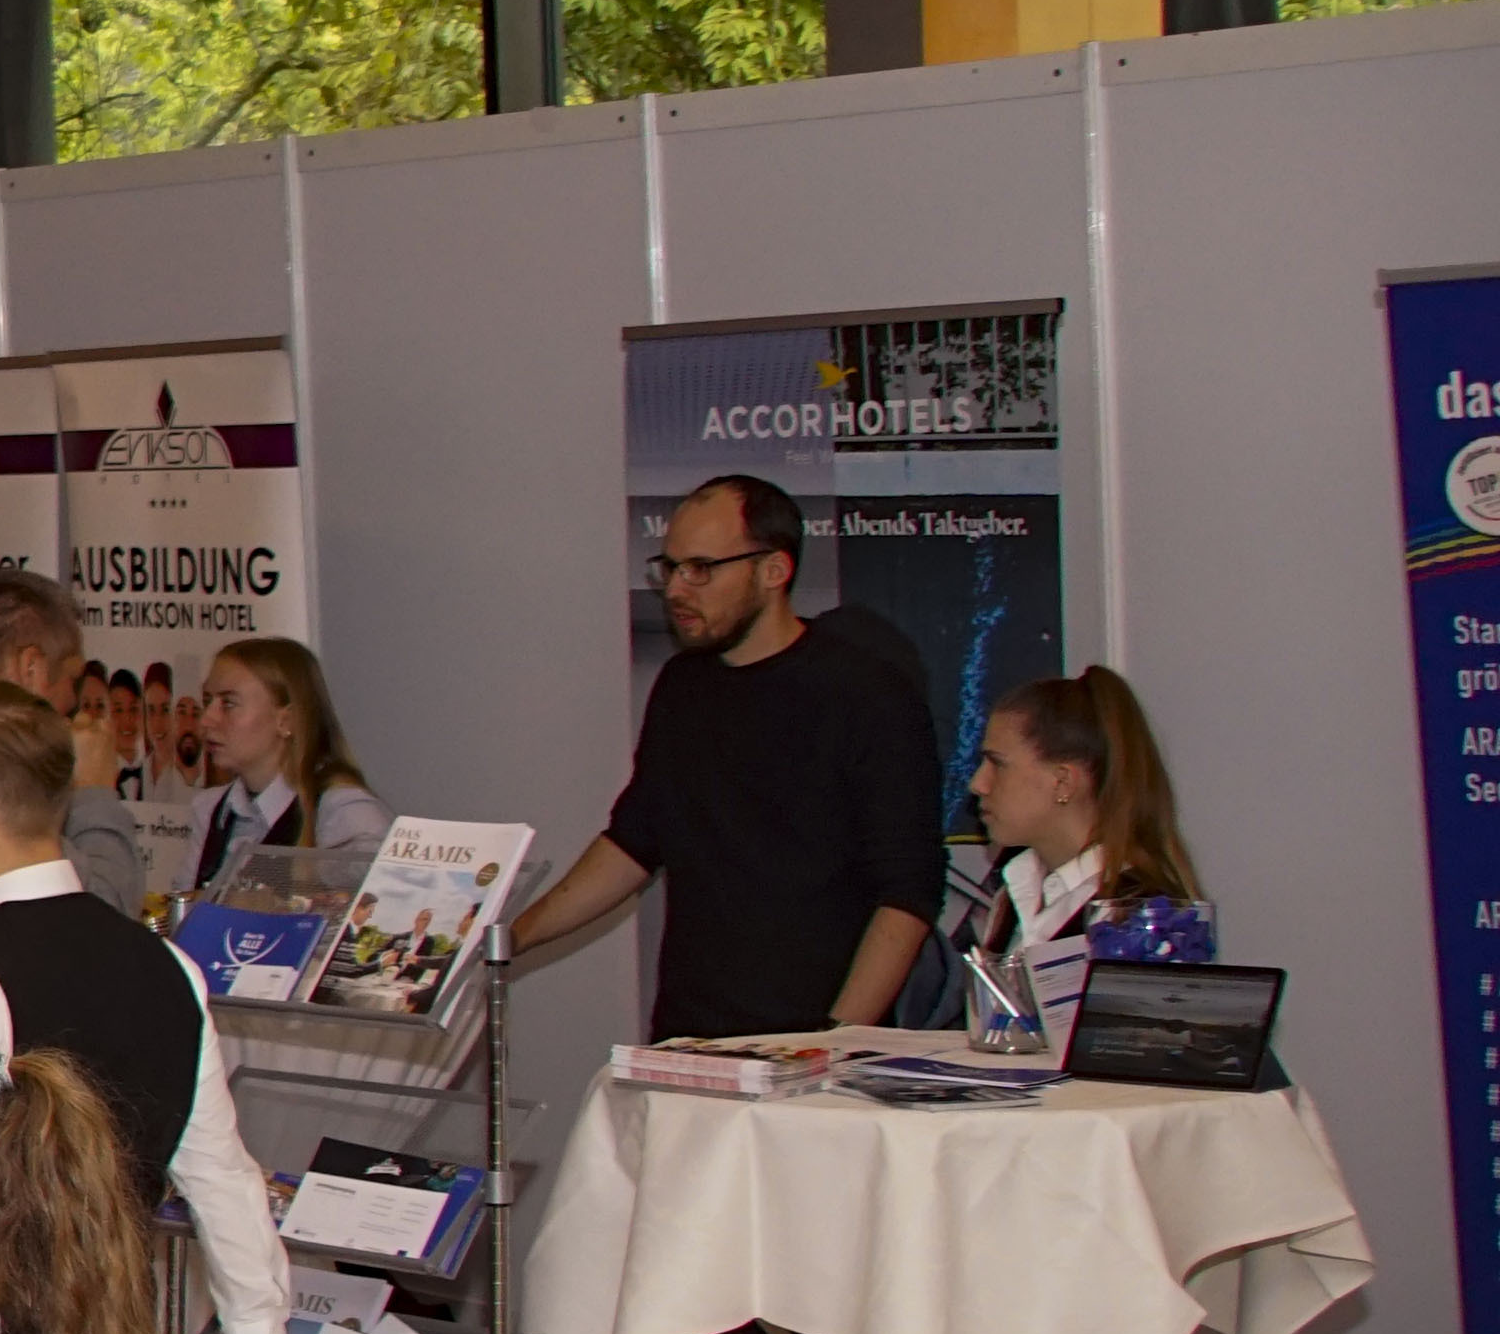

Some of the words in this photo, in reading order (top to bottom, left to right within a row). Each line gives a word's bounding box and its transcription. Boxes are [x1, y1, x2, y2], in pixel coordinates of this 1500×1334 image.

[839, 510, 918, 538] Abends
[920, 507, 1028, 545] Taktgeber.
[72, 546, 281, 596] AUSBILDUNG
[110, 601, 194, 630] ERIKSON
[200, 603, 258, 633] HOTEL
[393, 827, 422, 840] DAS
[384, 841, 475, 865] ARAMIS
[292, 1291, 336, 1316] MIS
